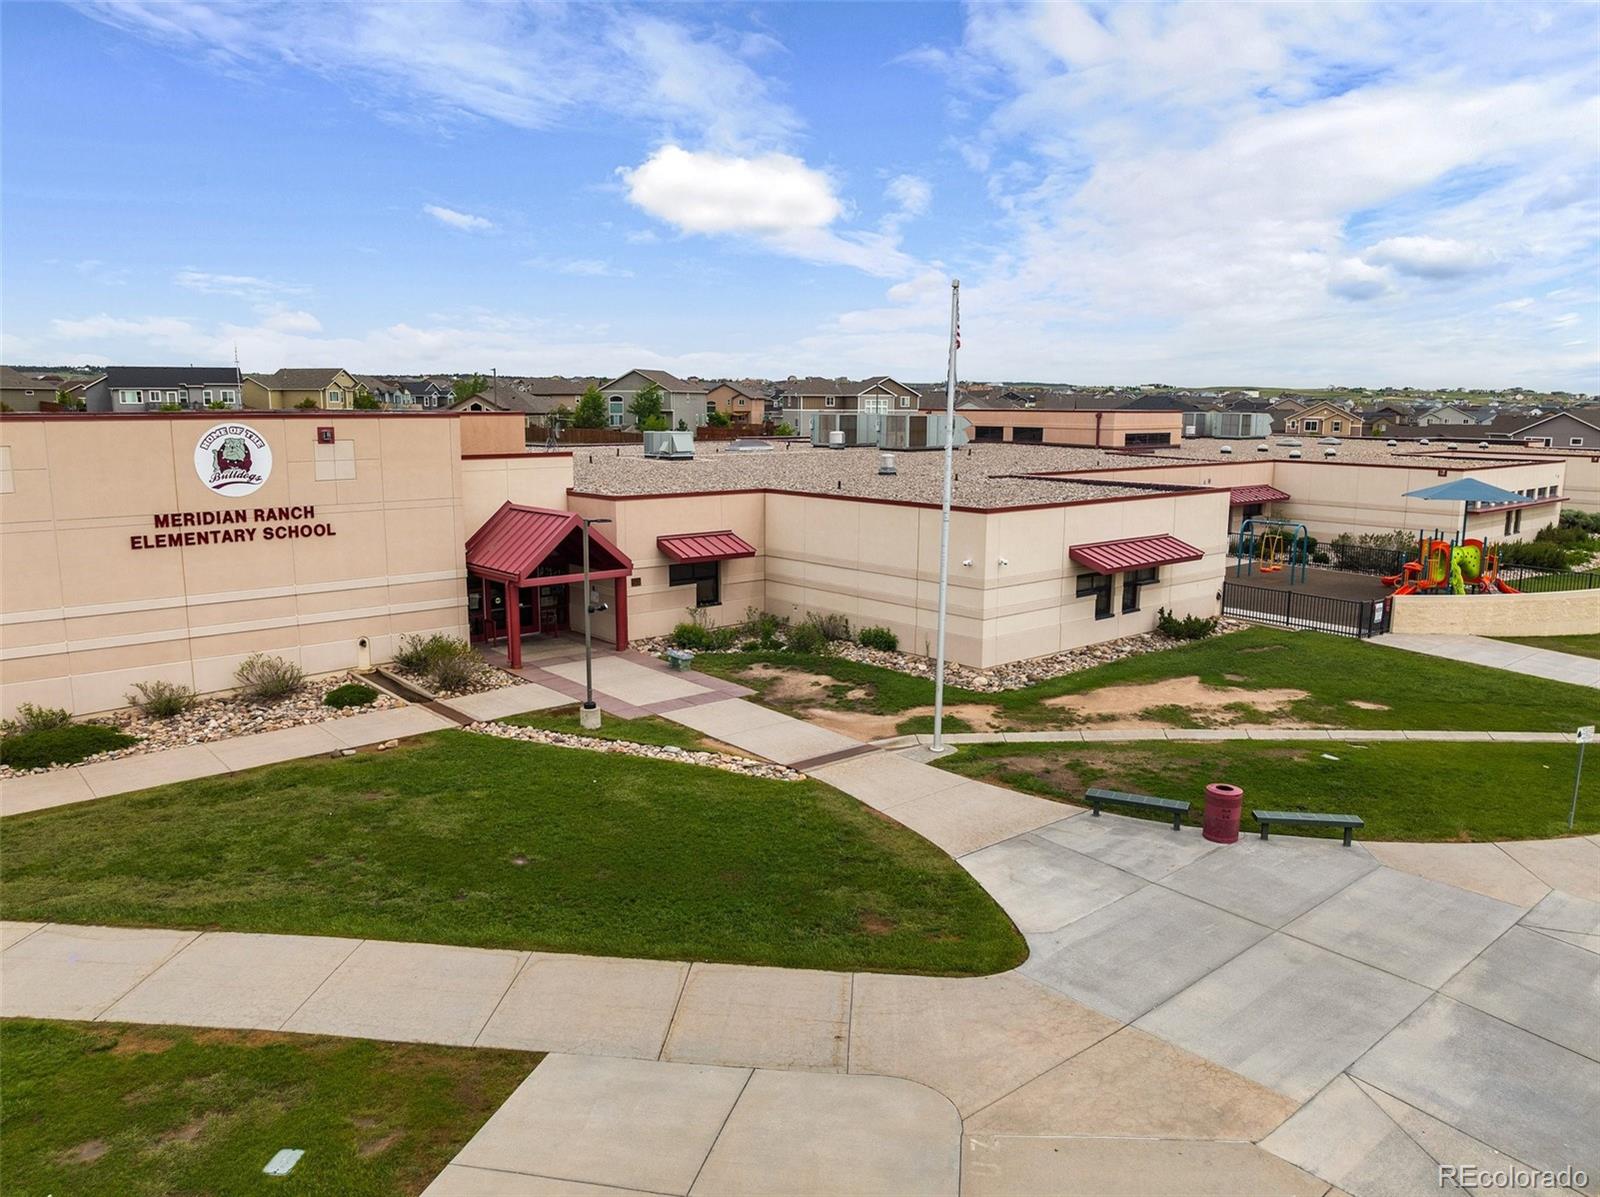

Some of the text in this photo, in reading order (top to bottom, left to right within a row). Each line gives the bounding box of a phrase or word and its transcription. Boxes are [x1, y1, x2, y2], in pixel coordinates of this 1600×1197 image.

[200, 426, 265, 450] HOME OF THE
[209, 470, 263, 483] Bulldogs
[154, 506, 314, 528] MERIDIAN RANCH
[130, 523, 336, 550] ELEMENTARY SCHOOL
